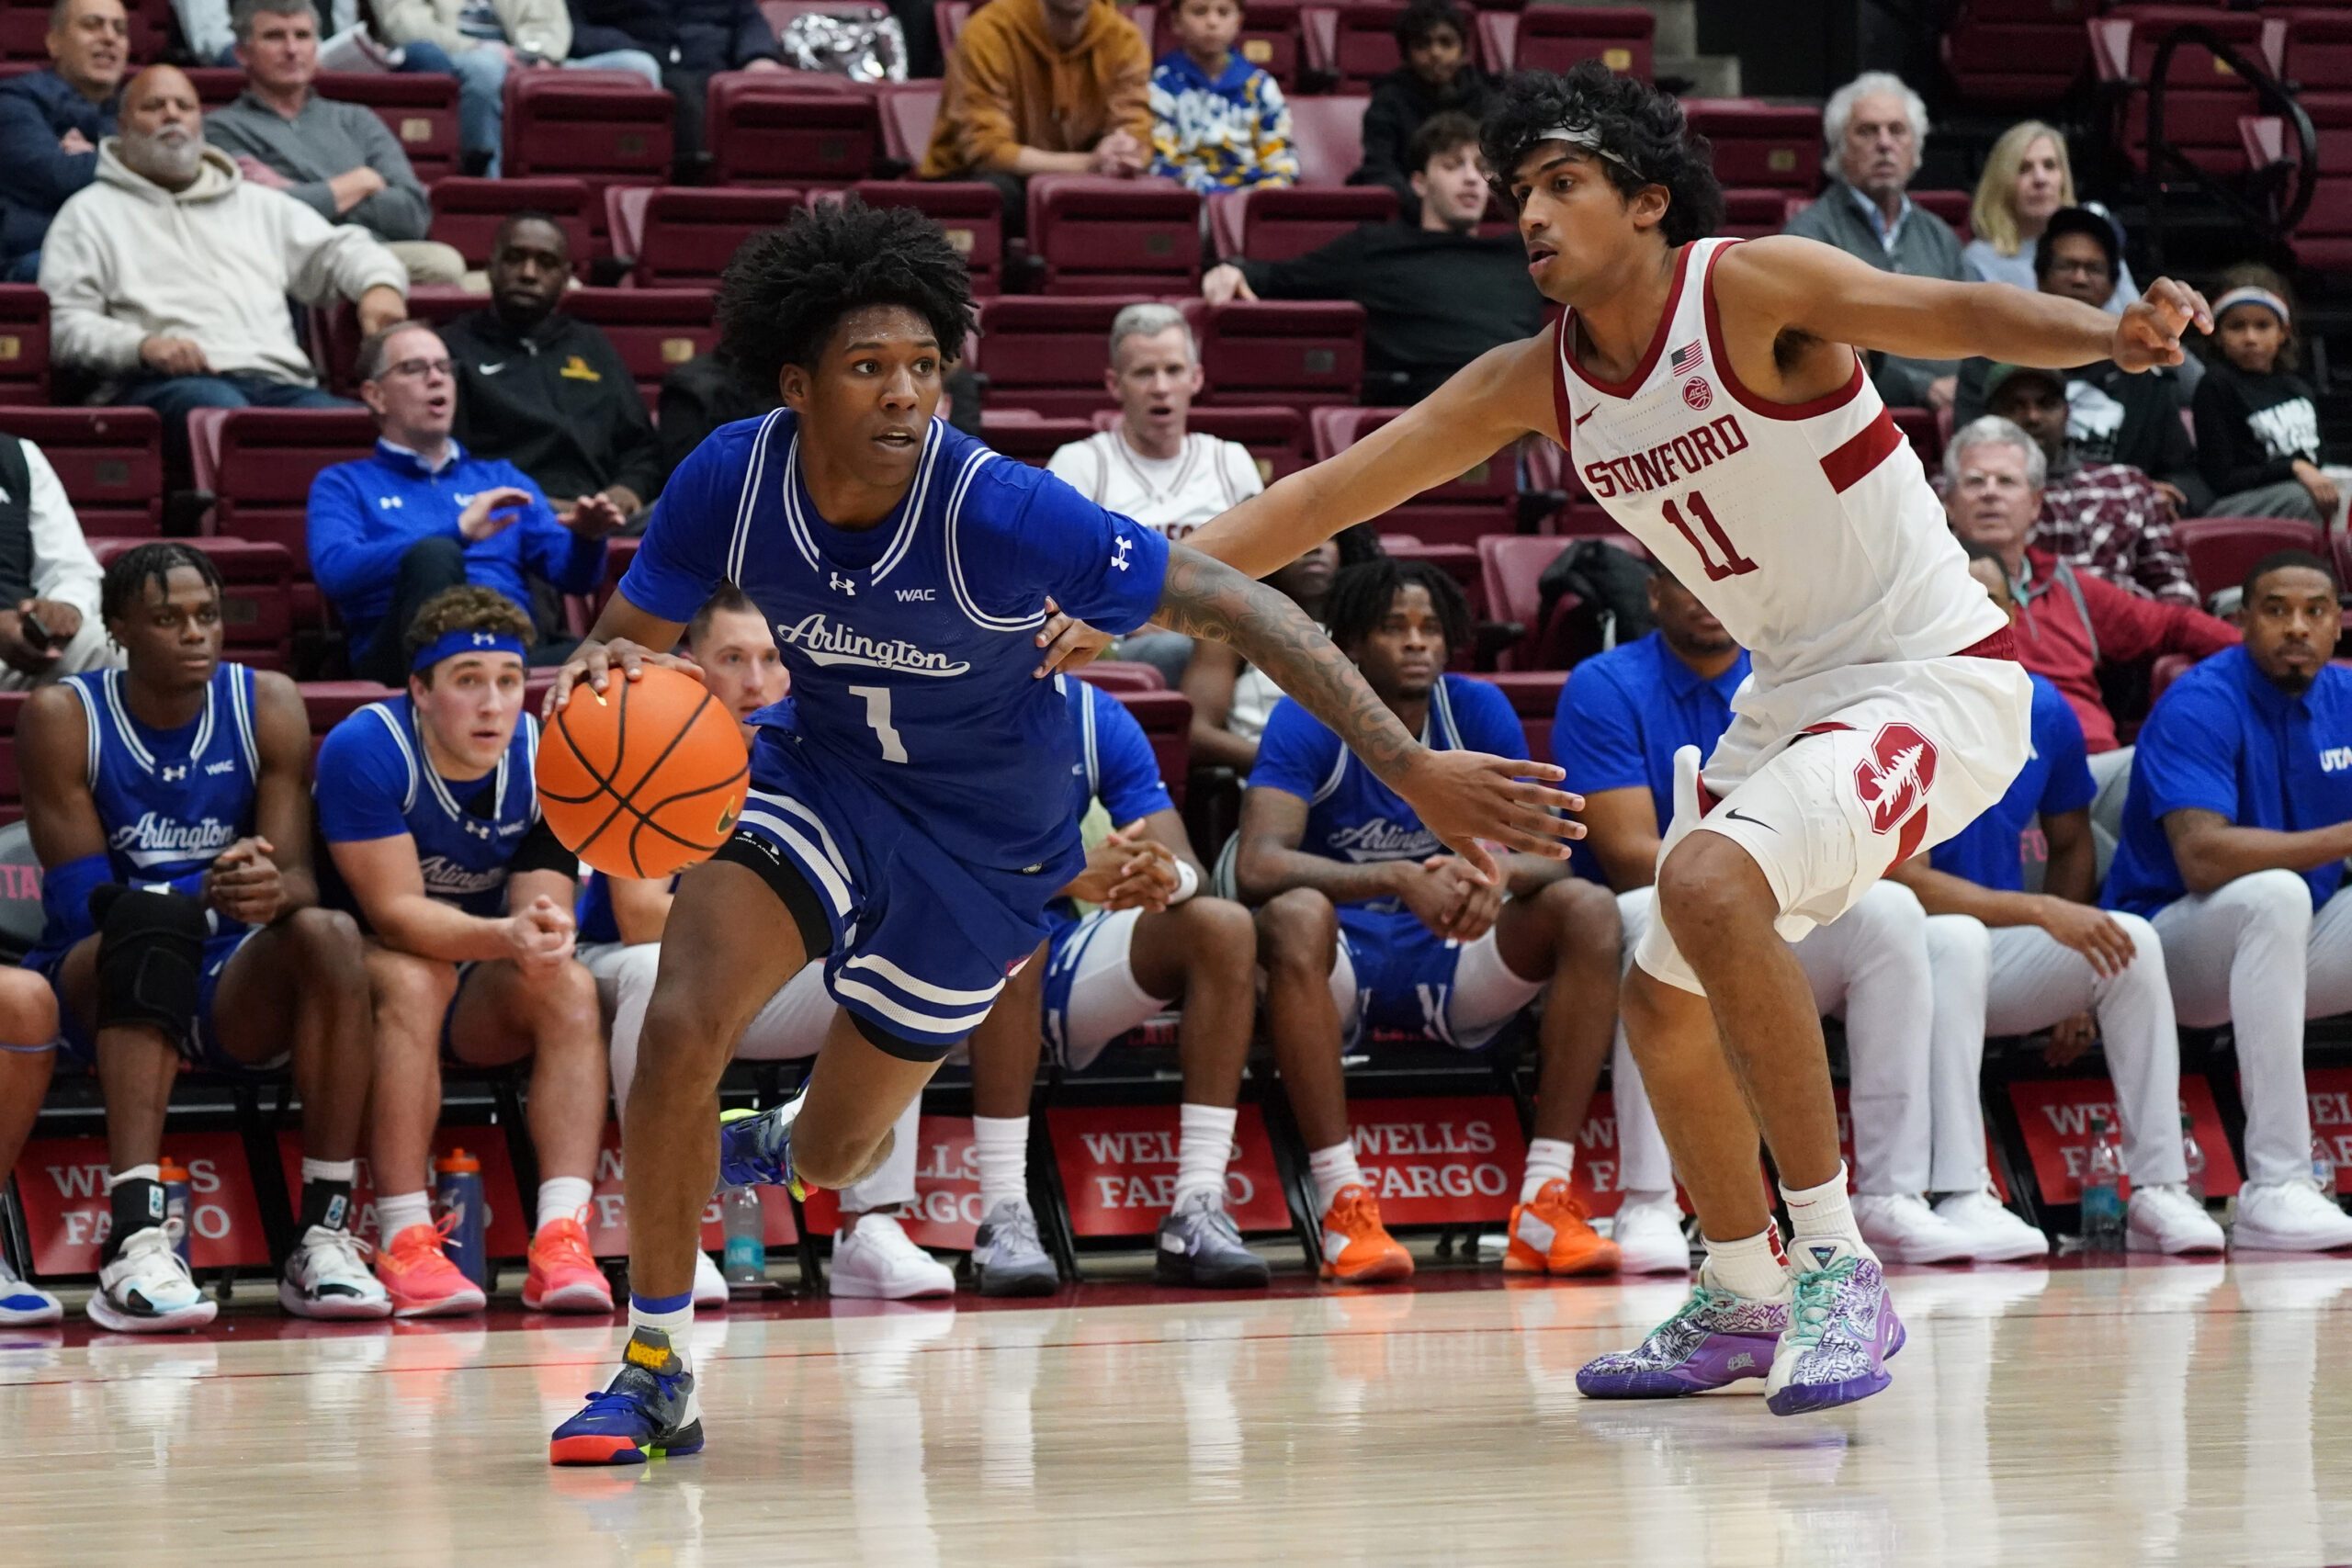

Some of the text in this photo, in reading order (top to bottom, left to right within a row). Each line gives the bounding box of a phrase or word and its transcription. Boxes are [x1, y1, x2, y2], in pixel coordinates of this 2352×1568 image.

[1689, 386, 1708, 398] ACC
[1584, 413, 1749, 498] STANFORD
[1661, 490, 1759, 581] 11
[895, 589, 935, 602] WAC
[777, 614, 971, 676] Arlington
[848, 685, 909, 764] 1
[1350, 1121, 1497, 1156] WELLS
